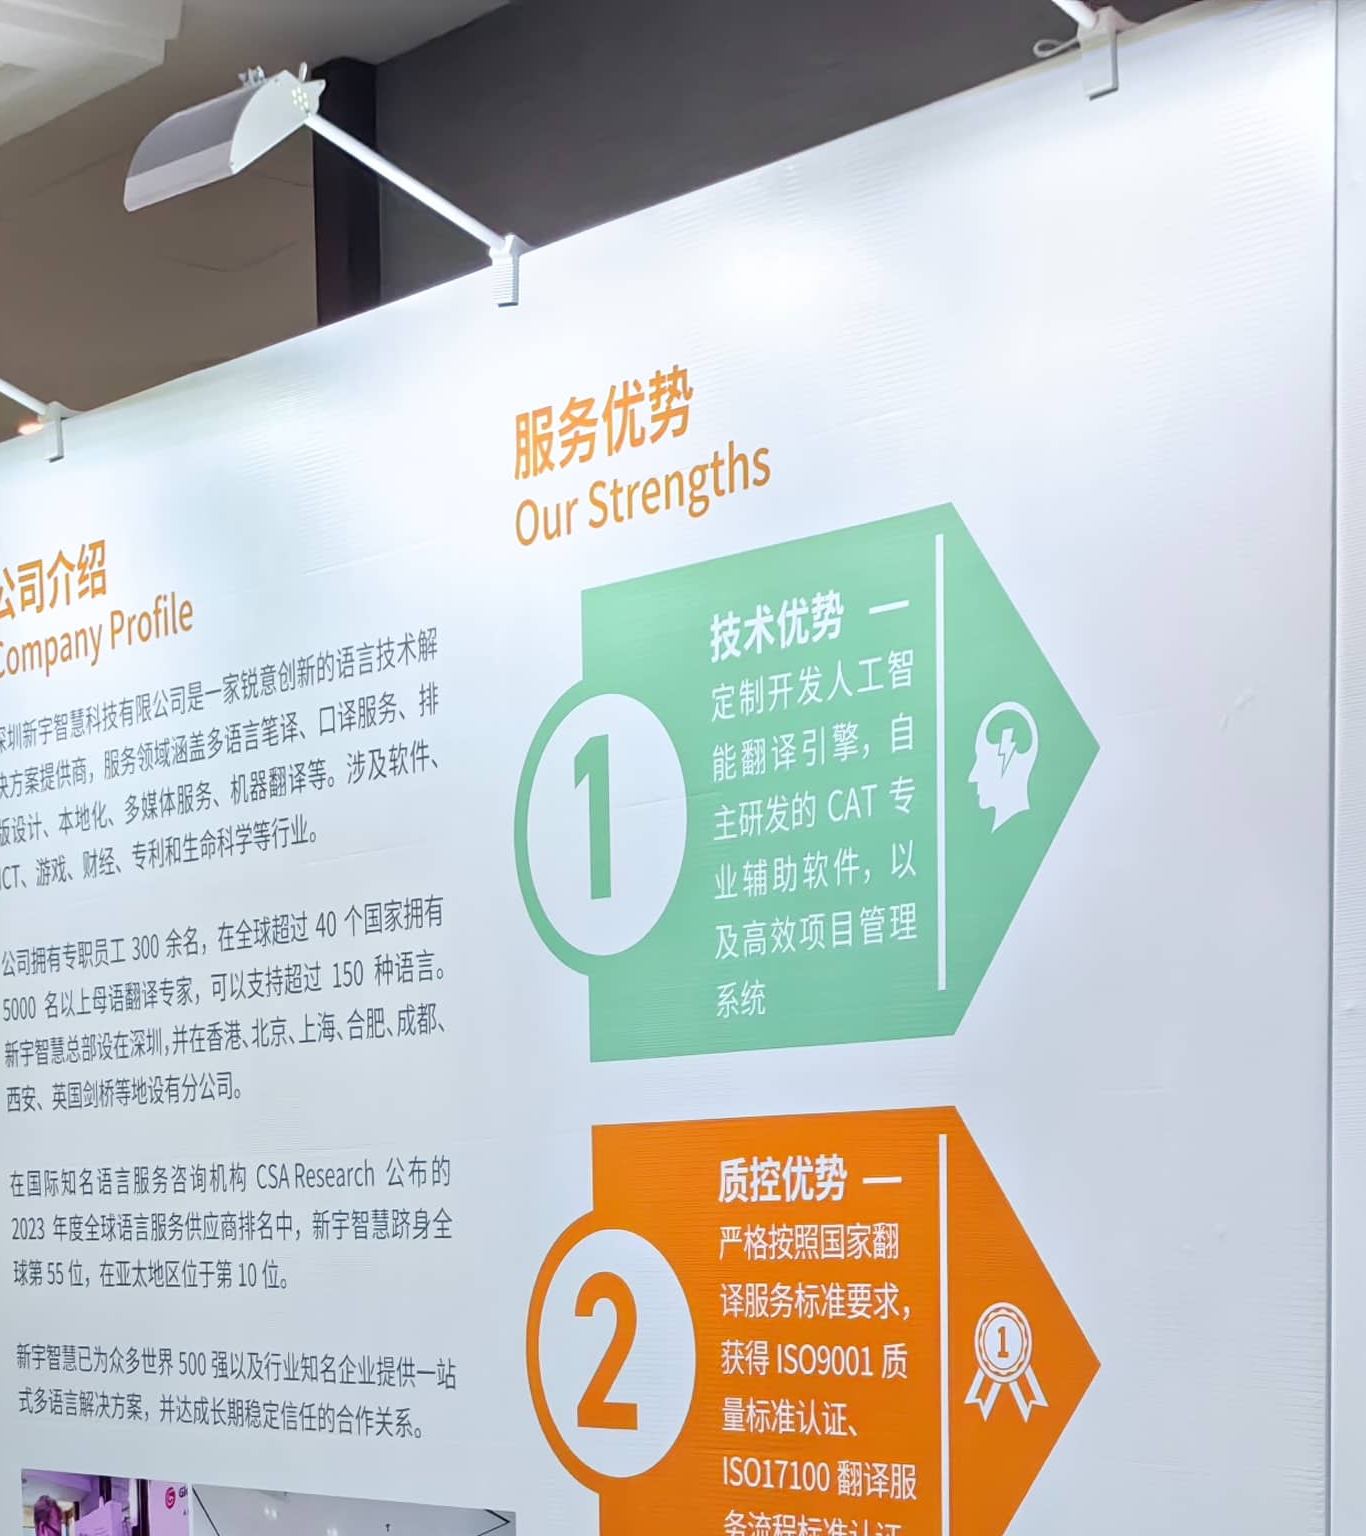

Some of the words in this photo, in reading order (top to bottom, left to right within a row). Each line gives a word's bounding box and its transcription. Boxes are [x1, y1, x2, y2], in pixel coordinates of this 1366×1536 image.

[514, 364, 695, 481] 服务优势
[514, 499, 579, 548] Our
[587, 441, 772, 529] Strengths
[110, 591, 194, 650] Profile
[710, 590, 845, 664] 技术优势
[711, 649, 915, 724] 定制开发人工智
[713, 712, 915, 785] 能翻译引擎，自
[574, 734, 613, 901] 1
[714, 789, 816, 842] 主研发的
[827, 784, 875, 822] CAT
[889, 774, 916, 815] 专
[714, 839, 918, 901] 业辅助软件，以
[1, 936, 126, 978] 公司拥有专职员工
[132, 933, 161, 961] 300
[165, 912, 309, 959] 余名，在全球超过
[315, 911, 337, 938] 40
[343, 895, 445, 936] 个国家拥有
[715, 903, 918, 962] 及高效项目管理
[3, 994, 37, 1022] 5000
[333, 959, 365, 988] 150
[374, 949, 445, 988] 种语言。
[715, 979, 766, 1019] 系统
[10, 1161, 248, 1198] 在国际知名语言服务咨询机构
[256, 1163, 290, 1191] CSA
[293, 1159, 376, 1190] Research
[385, 1154, 451, 1190] 公布的
[718, 1153, 848, 1204] 质控优势
[11, 1214, 46, 1242] 2023
[719, 1222, 900, 1262] 严格按照国家翻
[13, 1259, 43, 1288] 球第
[47, 1260, 65, 1287] 55
[68, 1258, 233, 1290] 位，在亚太地区位于第
[238, 1261, 258, 1288] 10
[262, 1258, 289, 1290] 位。
[720, 1281, 913, 1323] 译服务标准要求，
[16, 1342, 175, 1378] 新宇智慧已为众多世界
[178, 1350, 207, 1377] 500
[211, 1350, 458, 1391] 强以及行业知名企业提供一站
[575, 1271, 638, 1431] 2
[721, 1340, 770, 1378] 获得
[777, 1346, 875, 1378] ISO9001
[881, 1342, 909, 1380] 质
[721, 1397, 860, 1438] 量标准认证、
[722, 1455, 831, 1492] ISO17100
[836, 1460, 918, 1501] 翻译服
